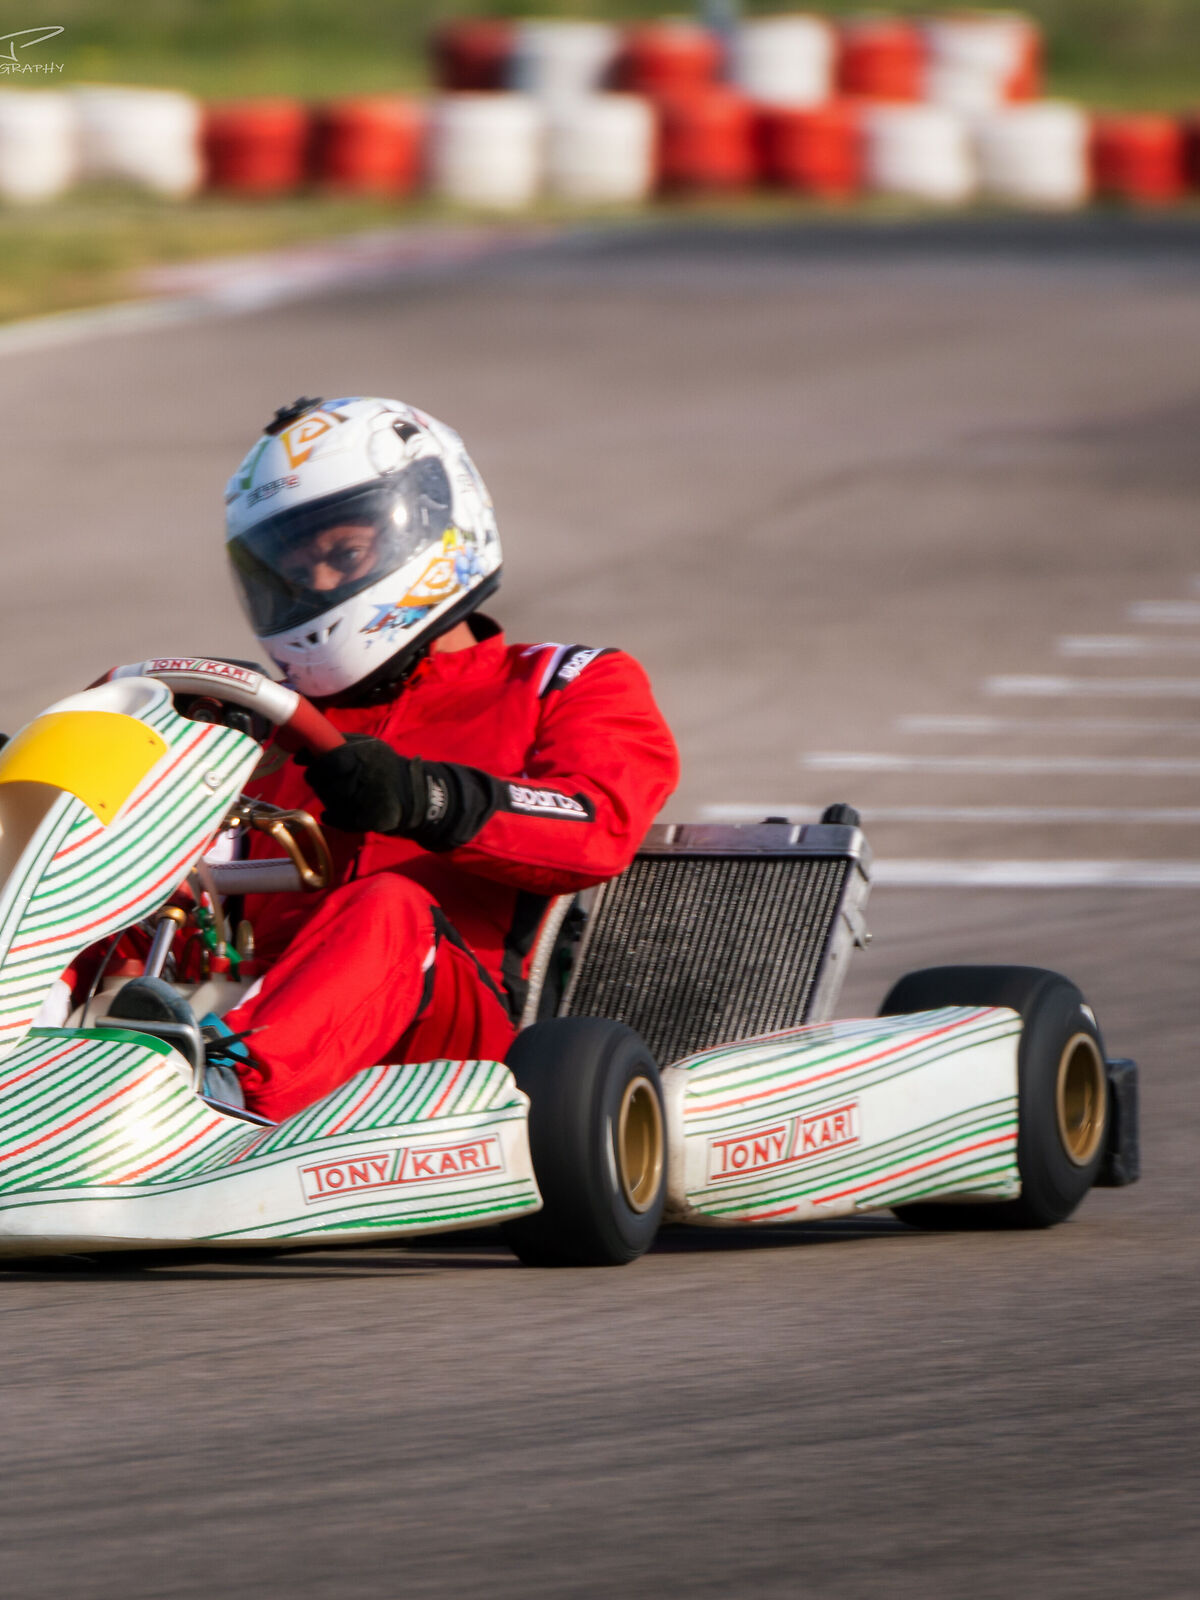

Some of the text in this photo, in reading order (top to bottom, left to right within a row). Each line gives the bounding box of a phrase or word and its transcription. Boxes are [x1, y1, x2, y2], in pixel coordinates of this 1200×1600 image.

[150, 659, 196, 671] TONY
[712, 1102, 858, 1171] TONY KART
[302, 1137, 497, 1192] TONY KART
